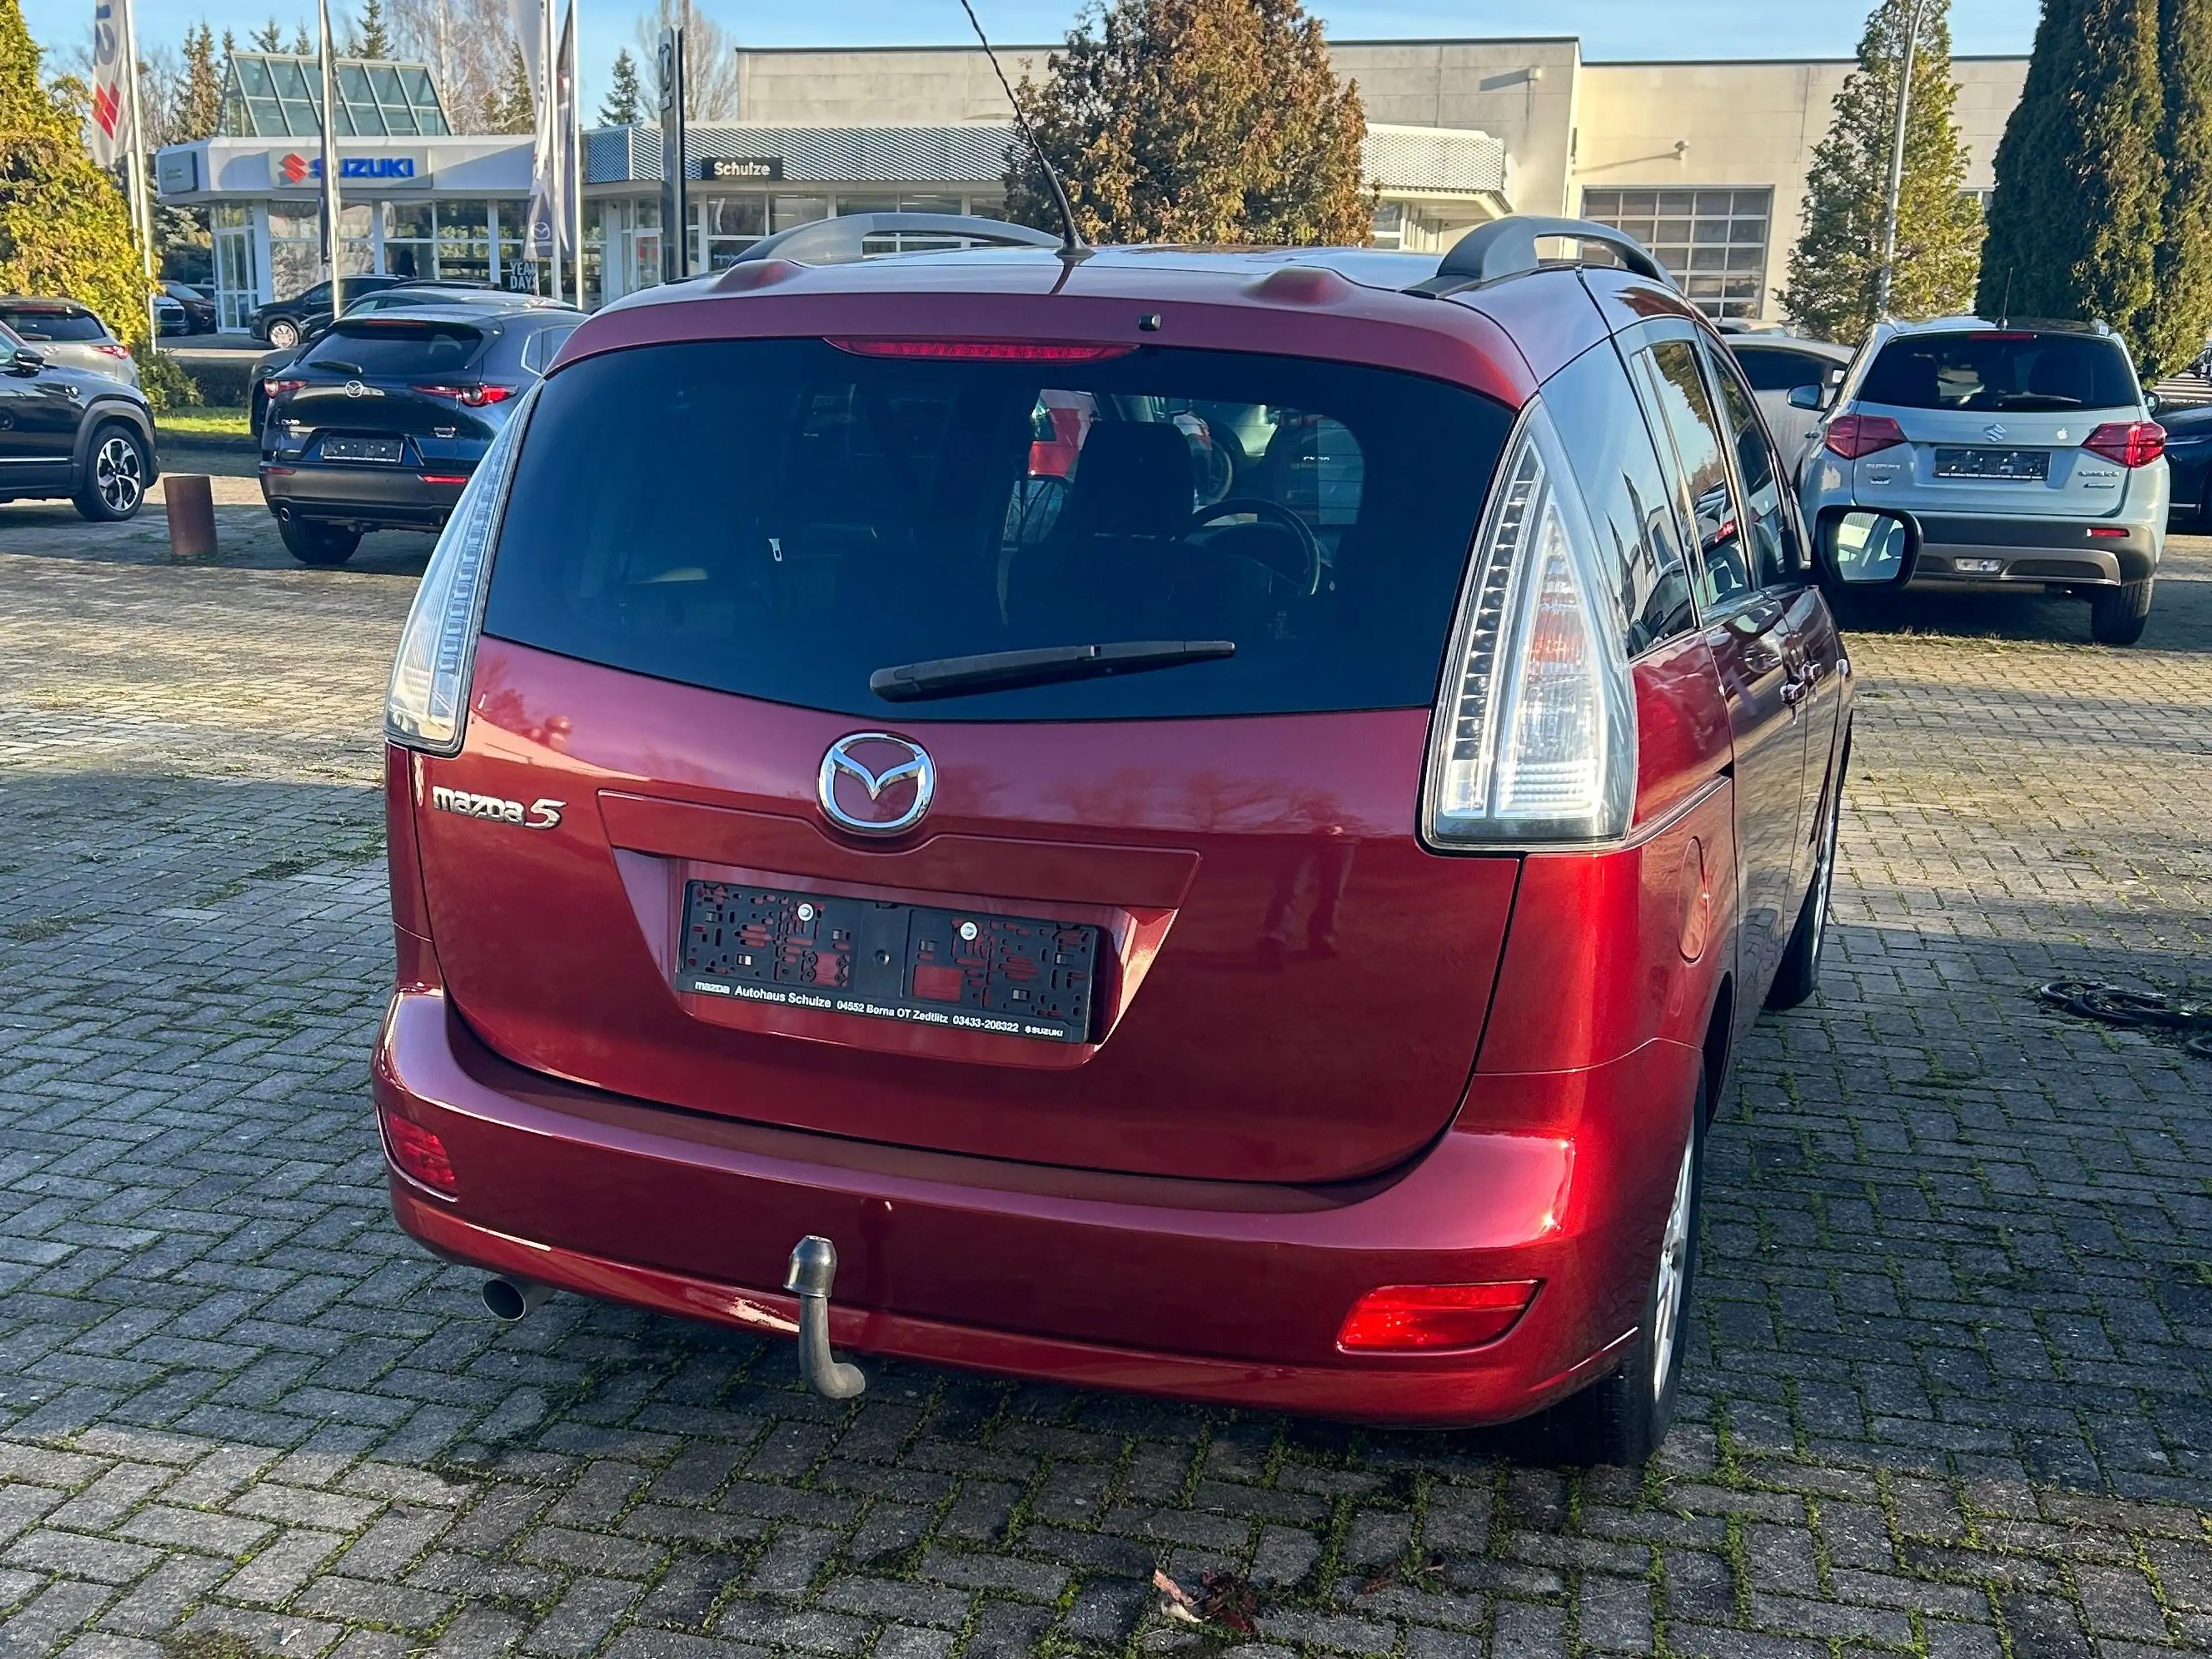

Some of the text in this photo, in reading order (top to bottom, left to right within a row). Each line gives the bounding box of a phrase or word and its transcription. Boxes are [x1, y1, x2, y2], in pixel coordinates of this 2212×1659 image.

[714, 161, 770, 176] Schulze
[734, 985, 786, 1002] Autohaus
[788, 993, 831, 1008] Schulze
[836, 1000, 865, 1013] 04552
[897, 1008, 911, 1018] OT
[912, 1010, 949, 1024] Zedtlitz
[1032, 1027, 1063, 1037] SUZUKI
